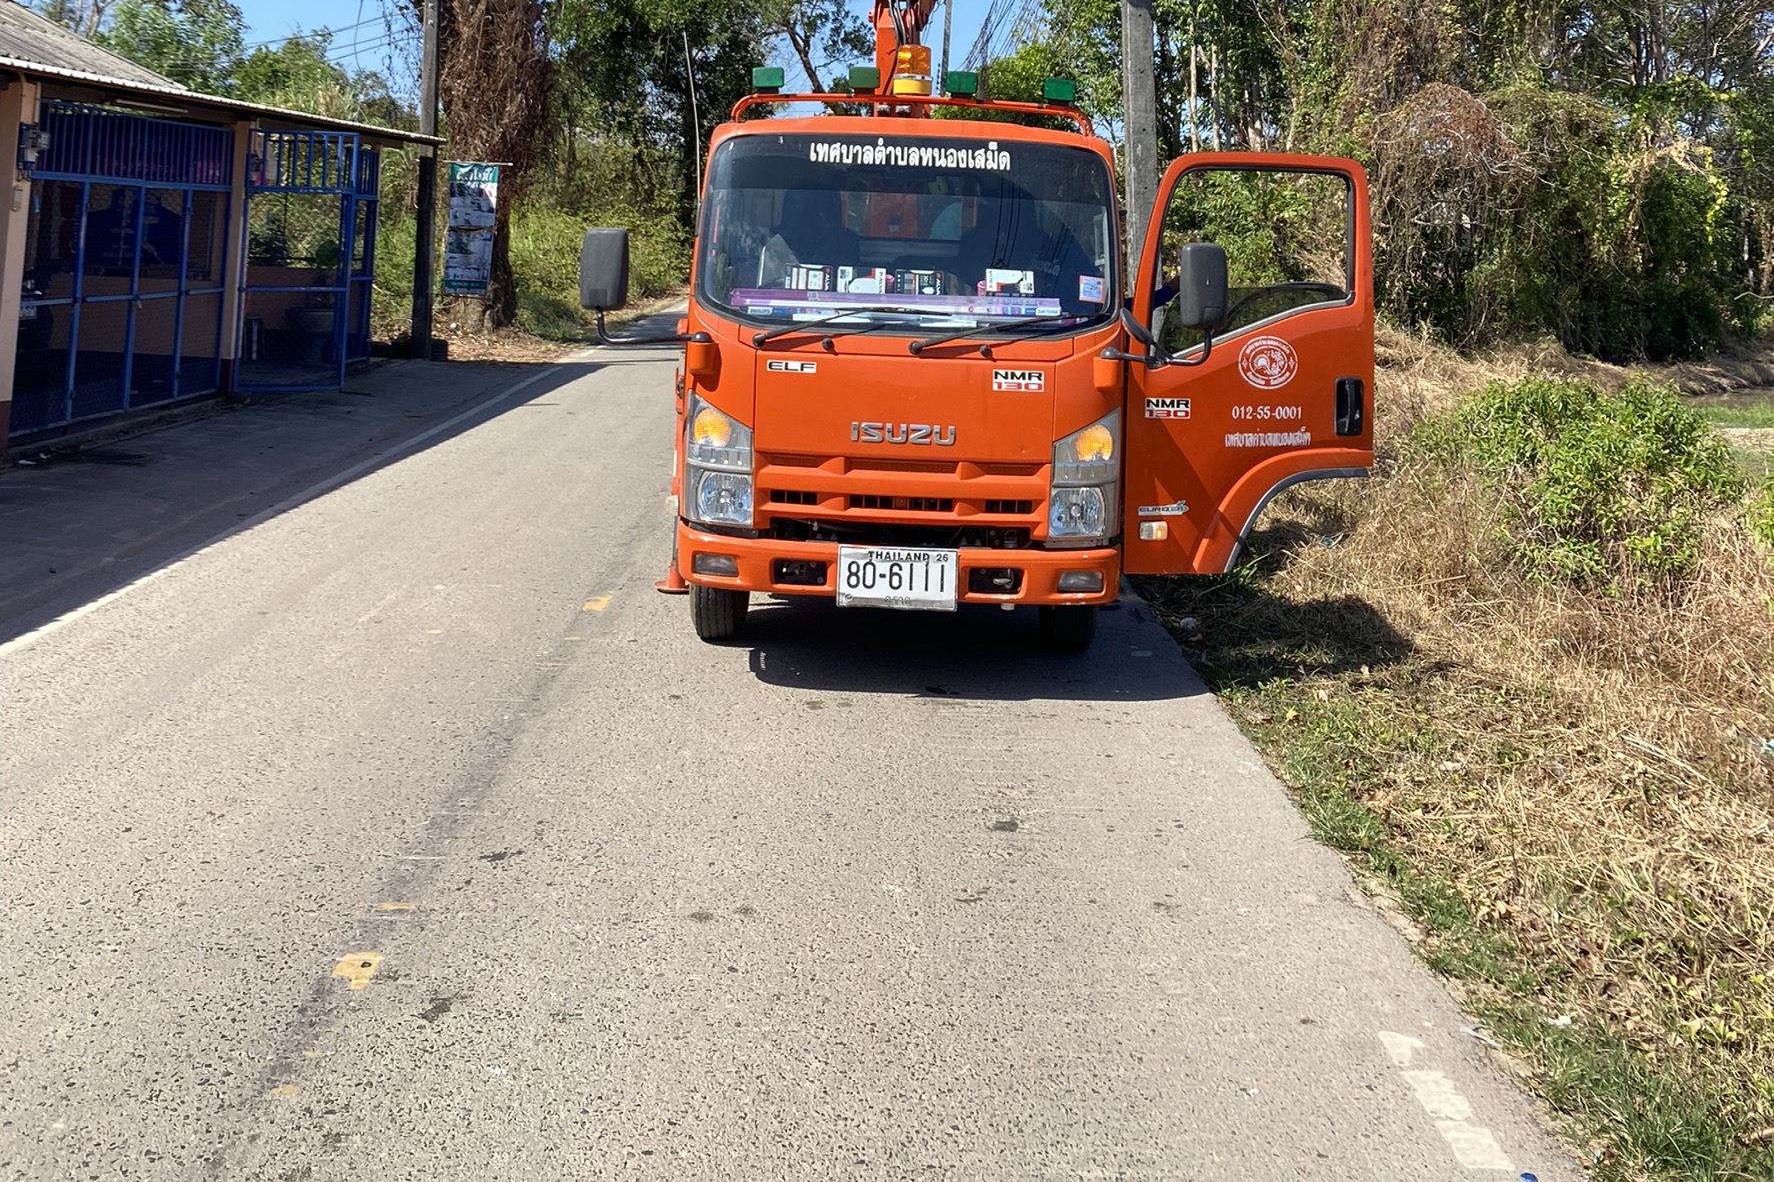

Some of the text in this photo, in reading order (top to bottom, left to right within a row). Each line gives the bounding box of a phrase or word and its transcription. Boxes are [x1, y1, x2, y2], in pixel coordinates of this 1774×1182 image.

[809, 137, 1012, 171] เทศบาลตำบลหนองเสม็ด
[768, 361, 815, 372] ELF
[994, 371, 1042, 381] NMR
[994, 382, 1043, 391] 130
[1146, 399, 1189, 408] NMR
[1147, 410, 1189, 418] 130
[1232, 406, 1302, 419] 012-55-0001
[851, 421, 956, 446] ISUZU
[868, 551, 949, 562] THAILAND 26
[847, 561, 945, 592] 80-6111
